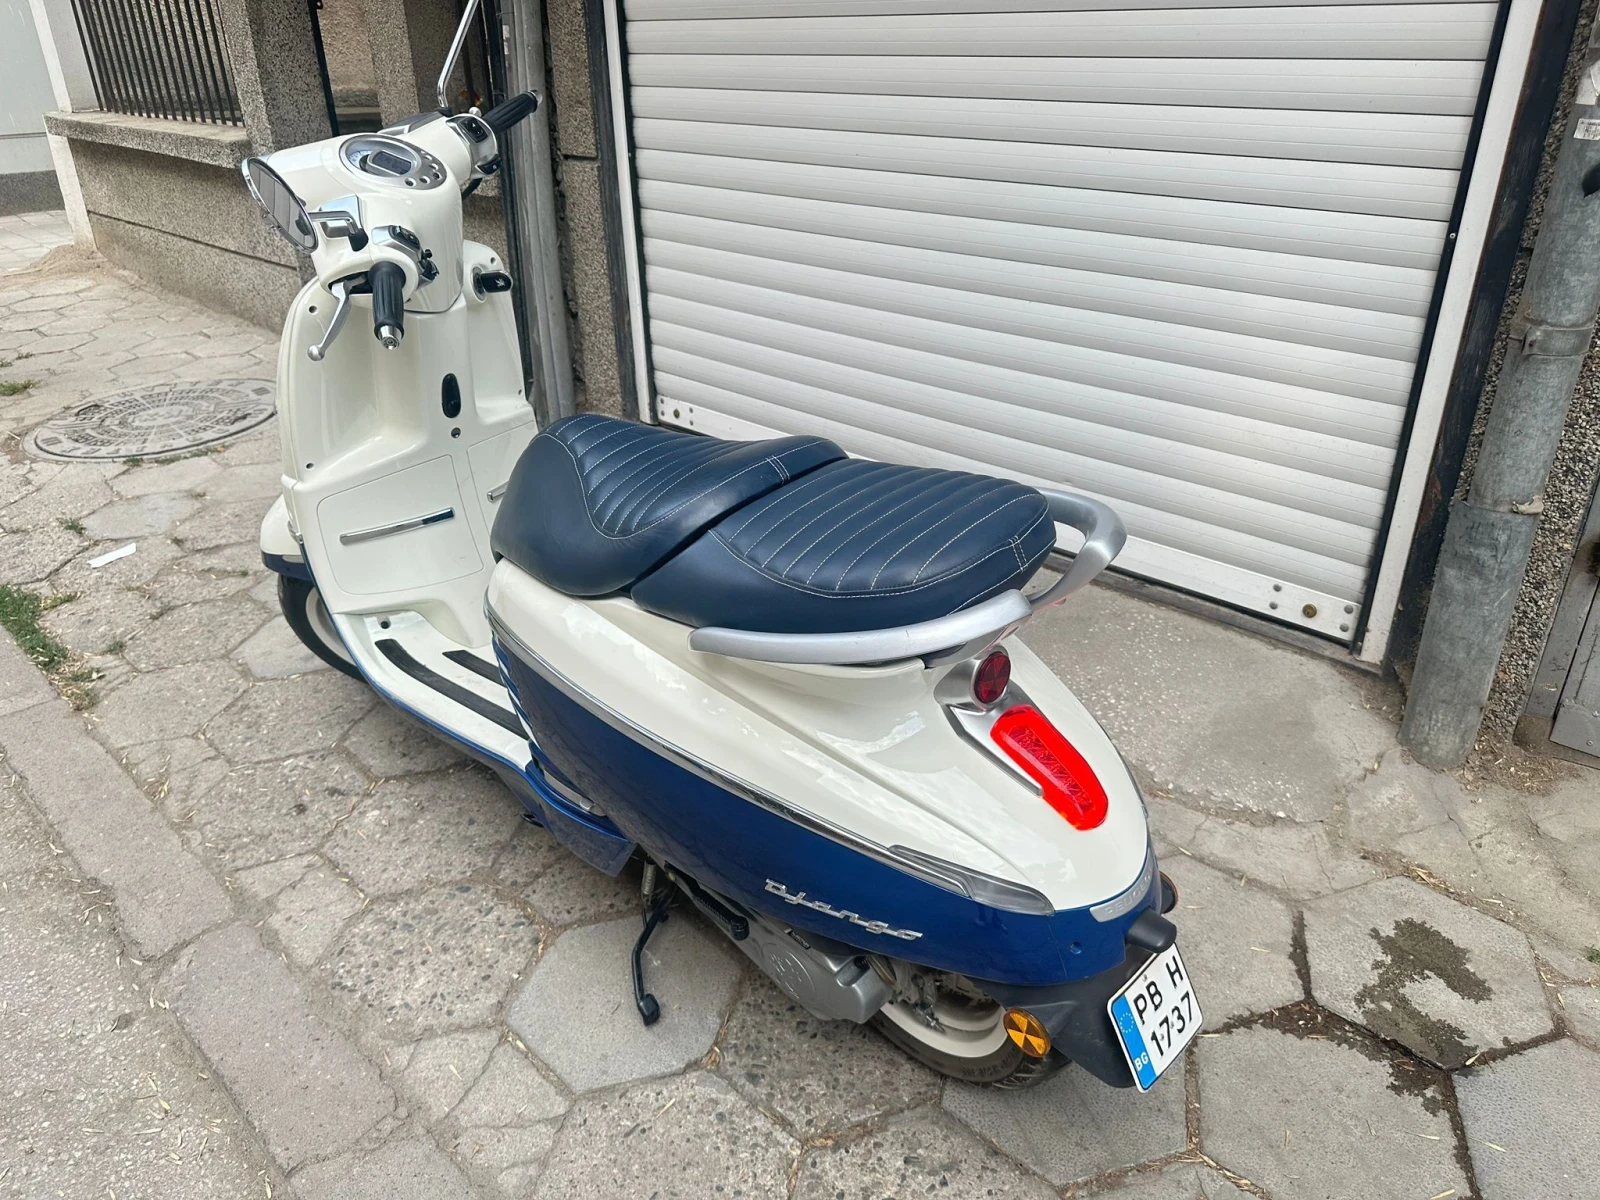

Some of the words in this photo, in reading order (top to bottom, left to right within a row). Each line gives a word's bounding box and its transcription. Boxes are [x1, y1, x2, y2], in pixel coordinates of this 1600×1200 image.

[764, 878, 924, 941] Django
[1133, 980, 1163, 1026] PB
[1165, 955, 1184, 990] H
[1150, 990, 1193, 1057] 1737
[1134, 1051, 1149, 1071] BG
